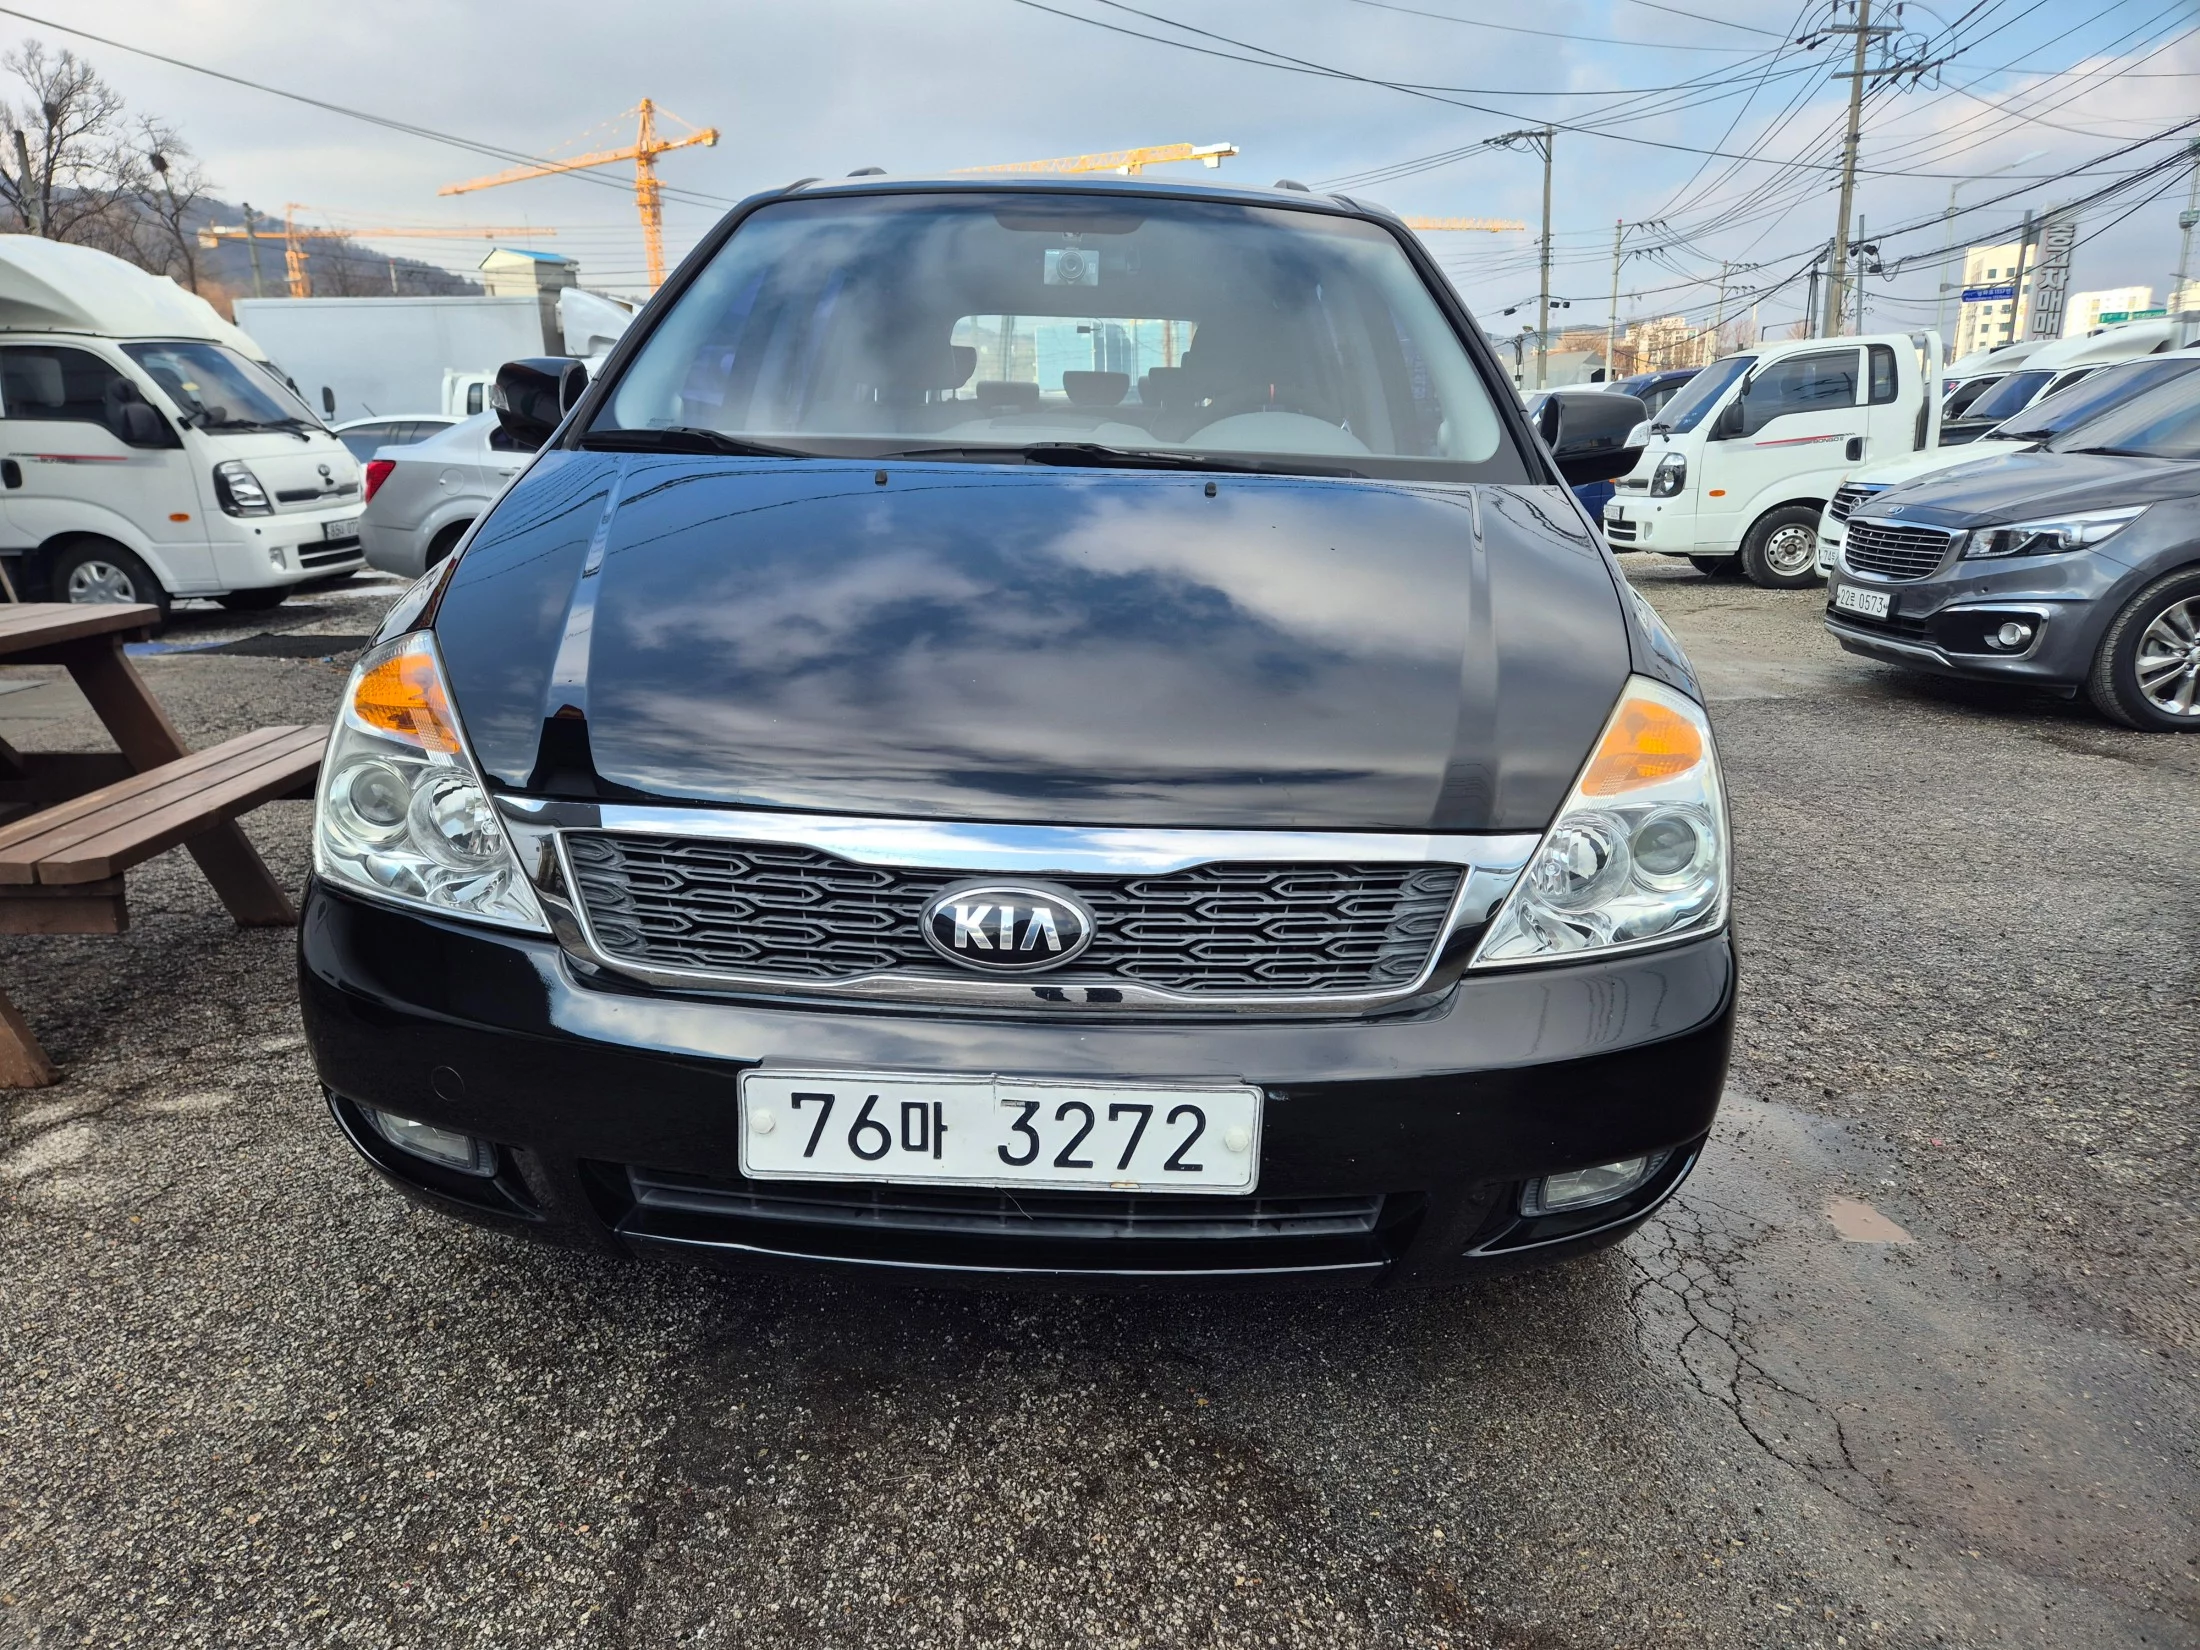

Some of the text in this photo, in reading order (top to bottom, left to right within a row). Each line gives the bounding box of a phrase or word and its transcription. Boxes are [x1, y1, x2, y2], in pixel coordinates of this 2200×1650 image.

[1840, 588, 1884, 613] 22로 0573
[953, 904, 1062, 951] KIA
[790, 1092, 1206, 1172] 76마 3272
